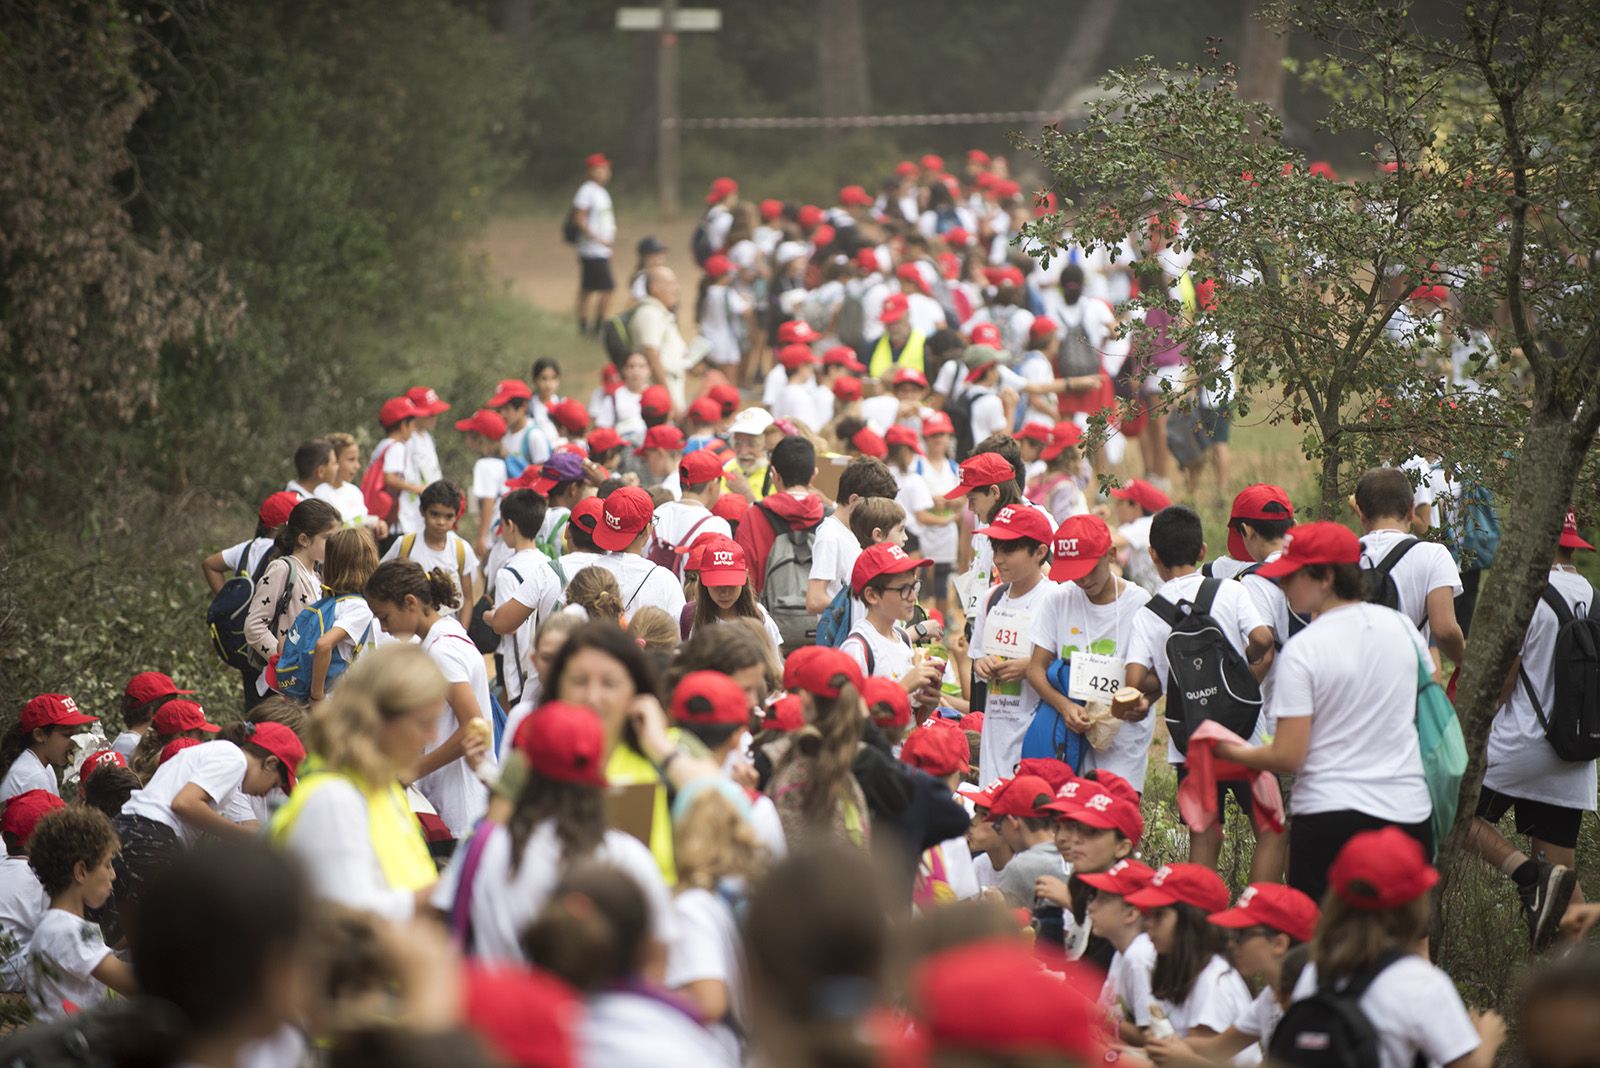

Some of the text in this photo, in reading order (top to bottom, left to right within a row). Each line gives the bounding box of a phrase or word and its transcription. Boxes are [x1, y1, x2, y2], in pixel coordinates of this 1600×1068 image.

[1058, 538, 1079, 551] TOT
[713, 551, 733, 561] TOT
[995, 628, 1019, 646] 431
[1089, 675, 1120, 694] 428
[96, 752, 117, 763] TOT
